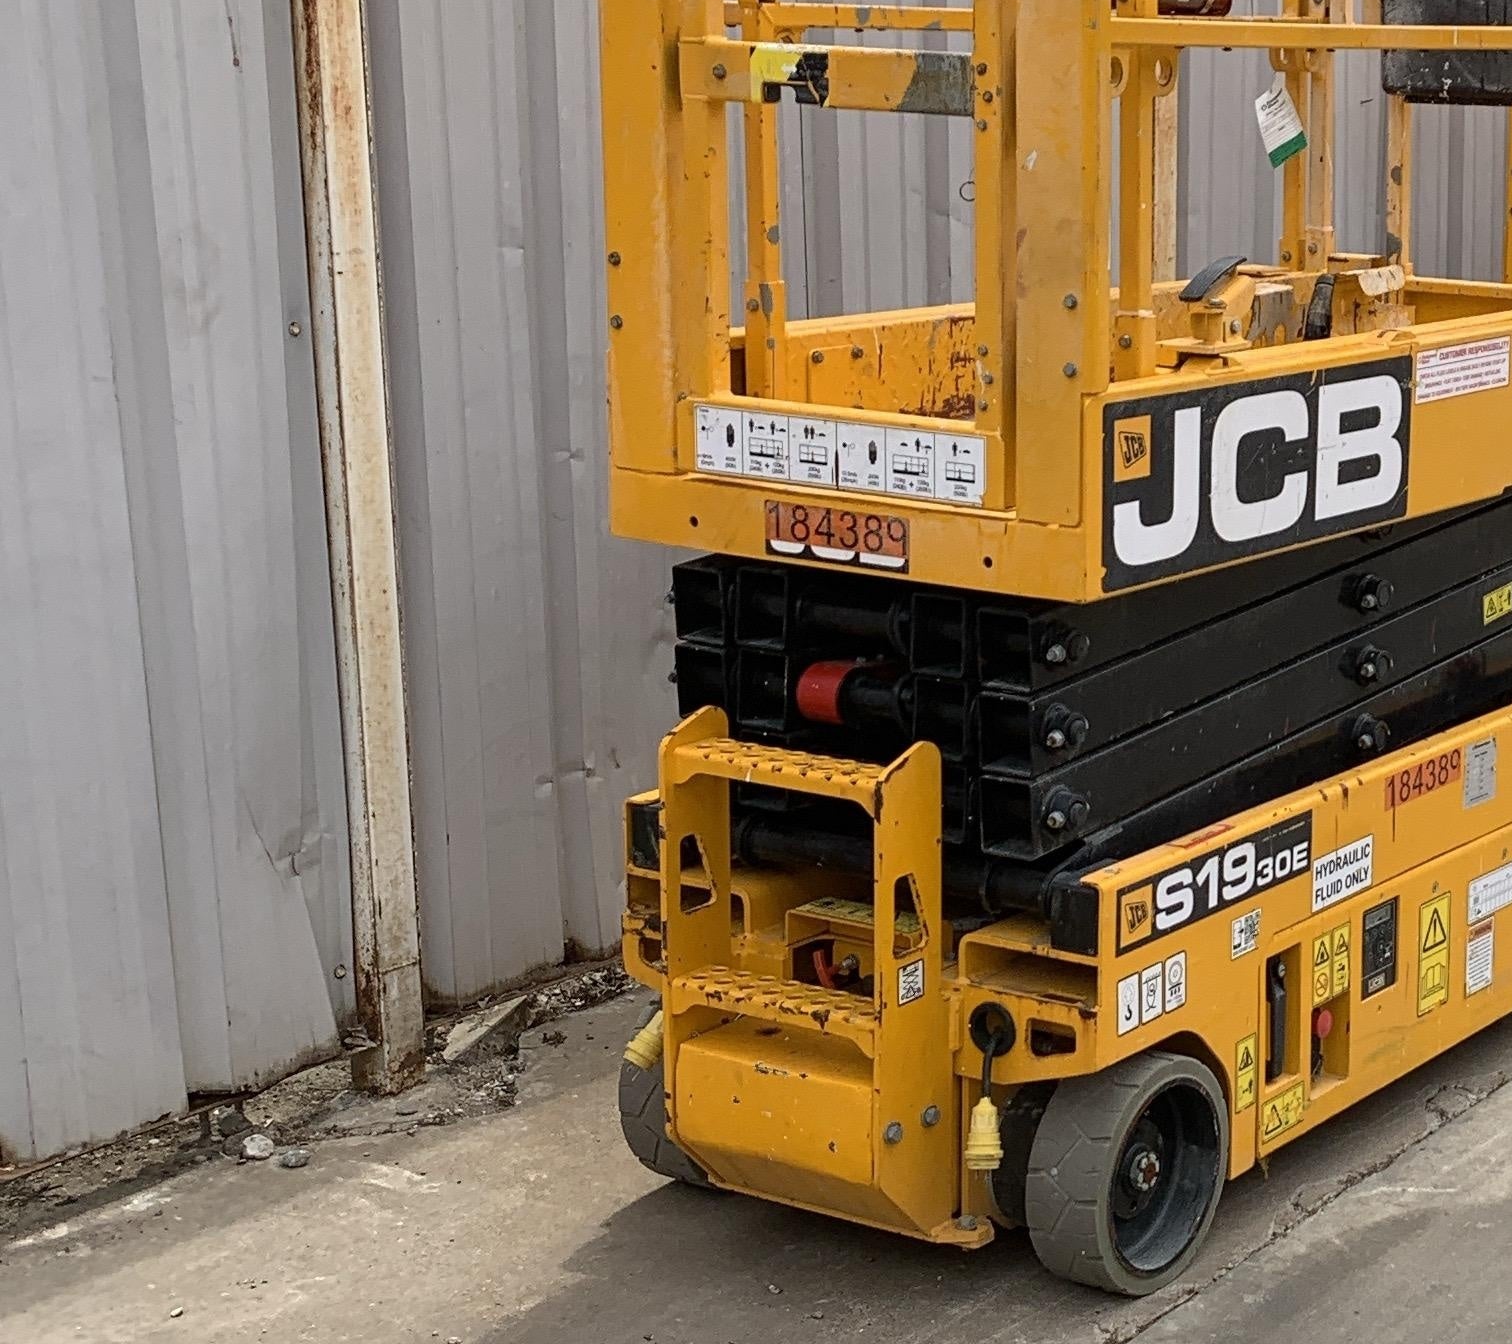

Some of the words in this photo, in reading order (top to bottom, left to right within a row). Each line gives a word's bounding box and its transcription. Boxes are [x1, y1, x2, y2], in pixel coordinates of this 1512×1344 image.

[1123, 432, 1146, 464] JCB
[1113, 375, 1402, 566] JCB
[768, 501, 907, 557] 184389
[1315, 842, 1371, 881] HYDRAULIC
[1315, 880, 1343, 902] FLUID
[1345, 865, 1370, 890] ONLY
[1127, 903, 1148, 929] JCB
